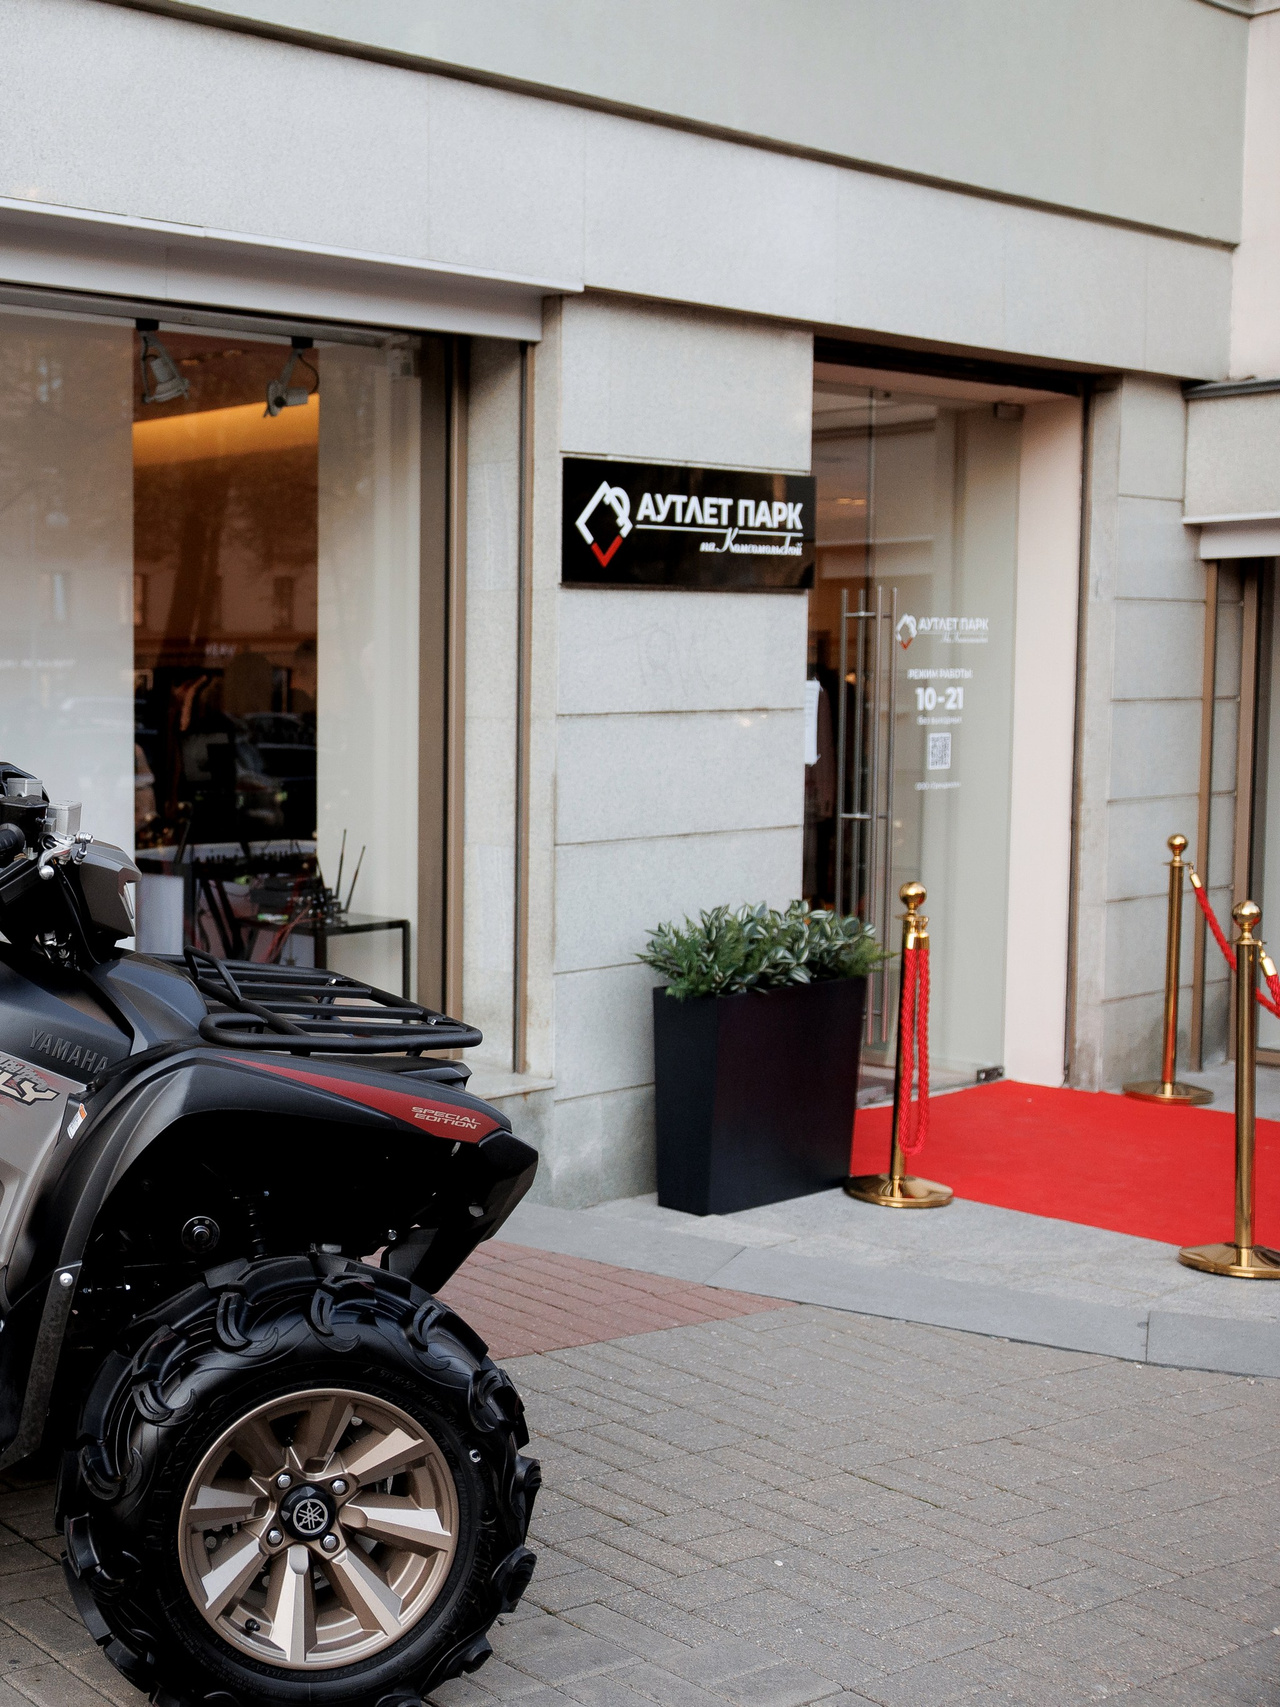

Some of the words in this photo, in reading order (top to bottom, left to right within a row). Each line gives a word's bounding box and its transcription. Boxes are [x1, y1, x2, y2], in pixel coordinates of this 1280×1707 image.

[636, 492, 733, 526] АУТЛЕТ
[737, 499, 804, 530] ПАРК
[918, 616, 959, 631] АУТЛЕТ
[960, 616, 989, 631] ПАРК
[915, 686, 964, 711] 10-21
[29, 1027, 109, 1075] YAMAHA
[411, 1106, 482, 1126] SPECIAL
[414, 1113, 478, 1130] EDITION
